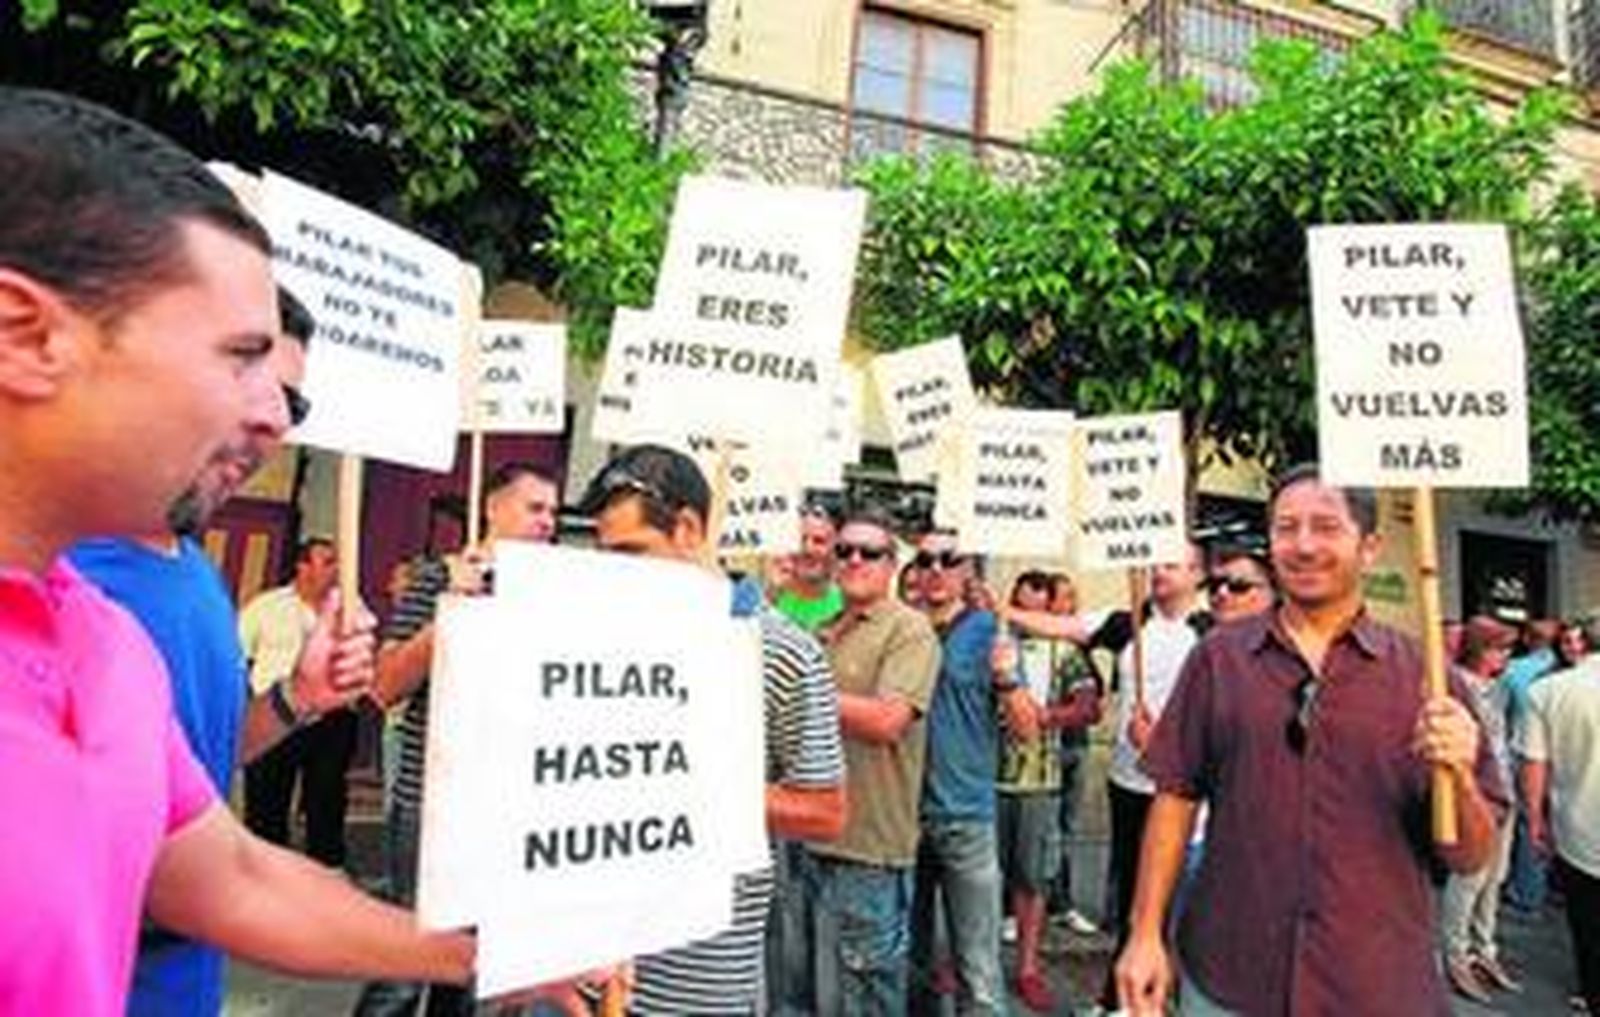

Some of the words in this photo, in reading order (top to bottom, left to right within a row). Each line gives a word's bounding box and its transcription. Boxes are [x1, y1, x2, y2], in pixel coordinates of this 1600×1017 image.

[696, 245, 808, 282] PILAR,
[1344, 243, 1465, 270] PILAR,
[324, 293, 361, 316] NO
[697, 295, 788, 329] ERES
[1341, 294, 1438, 319] VETE
[1451, 293, 1474, 317] Y
[481, 335, 523, 353] LAR
[1389, 341, 1442, 366] NO
[648, 340, 817, 383] HISTORIA
[1331, 391, 1508, 417] VUELVAS
[1381, 439, 1462, 471] MÁS
[727, 496, 788, 516] LVAS
[1109, 486, 1141, 501] NO
[974, 502, 1047, 520] NUNCA
[542, 662, 688, 704] PILAR,
[534, 740, 689, 784] HASTA
[525, 815, 694, 871] NUNCA
